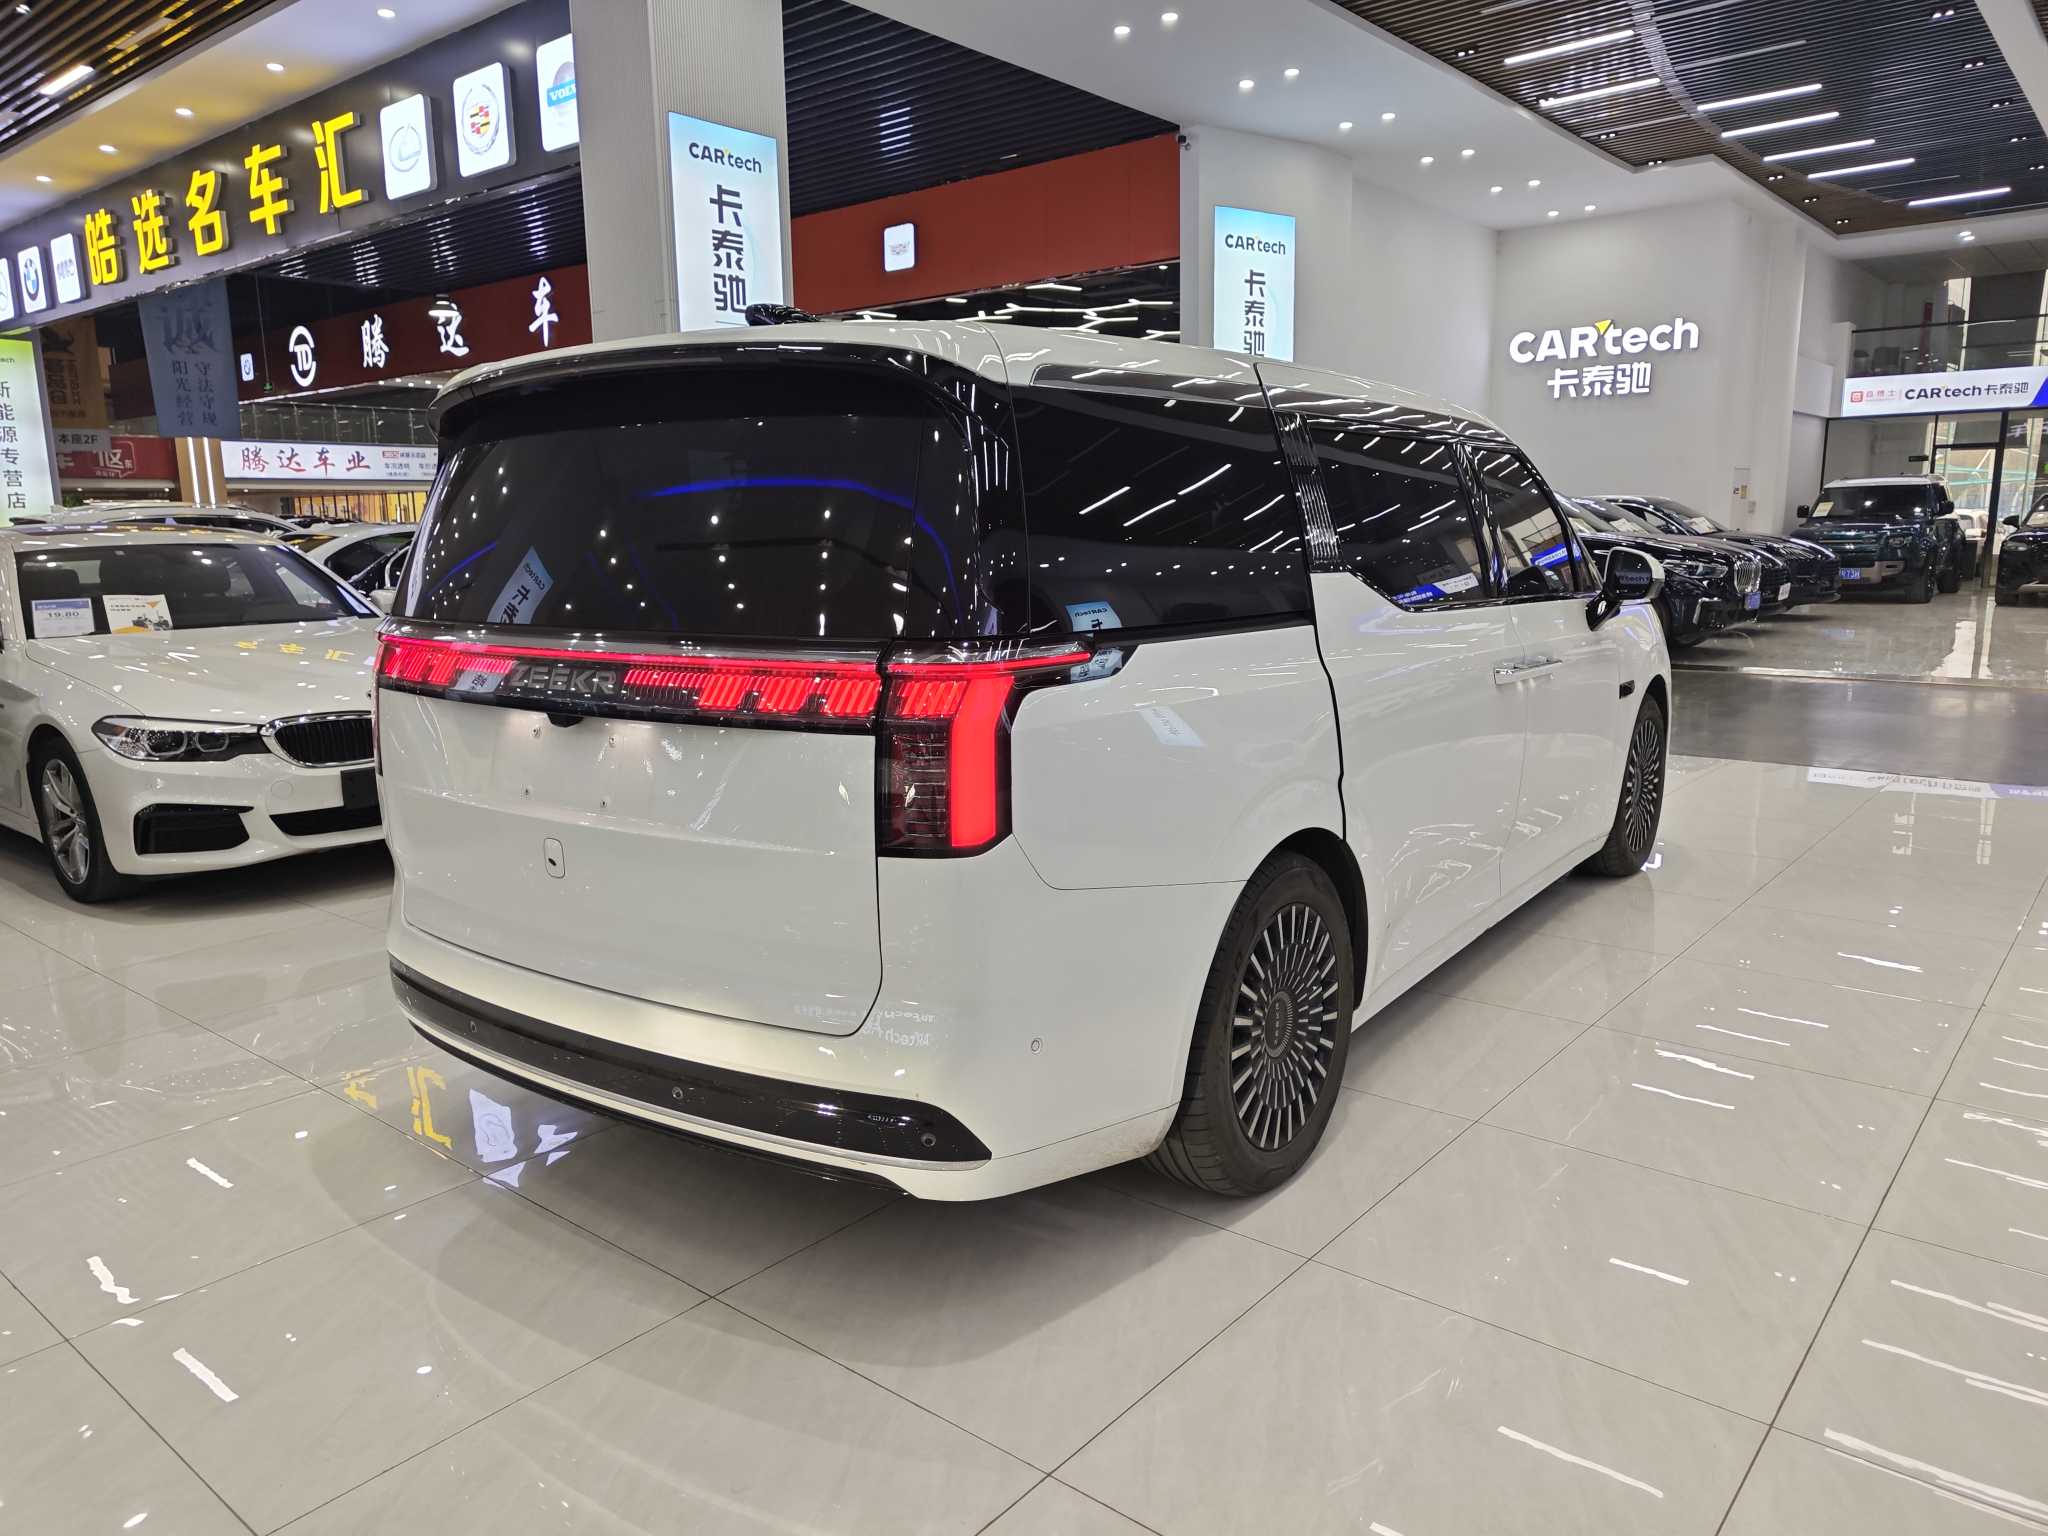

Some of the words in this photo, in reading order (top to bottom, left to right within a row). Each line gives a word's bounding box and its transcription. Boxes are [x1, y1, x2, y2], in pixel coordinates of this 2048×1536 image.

[688, 142, 763, 173] CARtech
[84, 111, 367, 286] 皓选名车汇
[709, 184, 747, 314] 卡泰驰
[1225, 234, 1286, 255] CARtech
[1244, 269, 1266, 357] 卡泰驰
[1509, 317, 1700, 364] CARtech
[1547, 361, 1652, 399] 卡泰驰
[1904, 385, 1982, 400] CARtech
[1983, 381, 2029, 396] 卡泰驰
[241, 445, 371, 478] 腾达车业
[510, 663, 616, 694] ZEEKR
